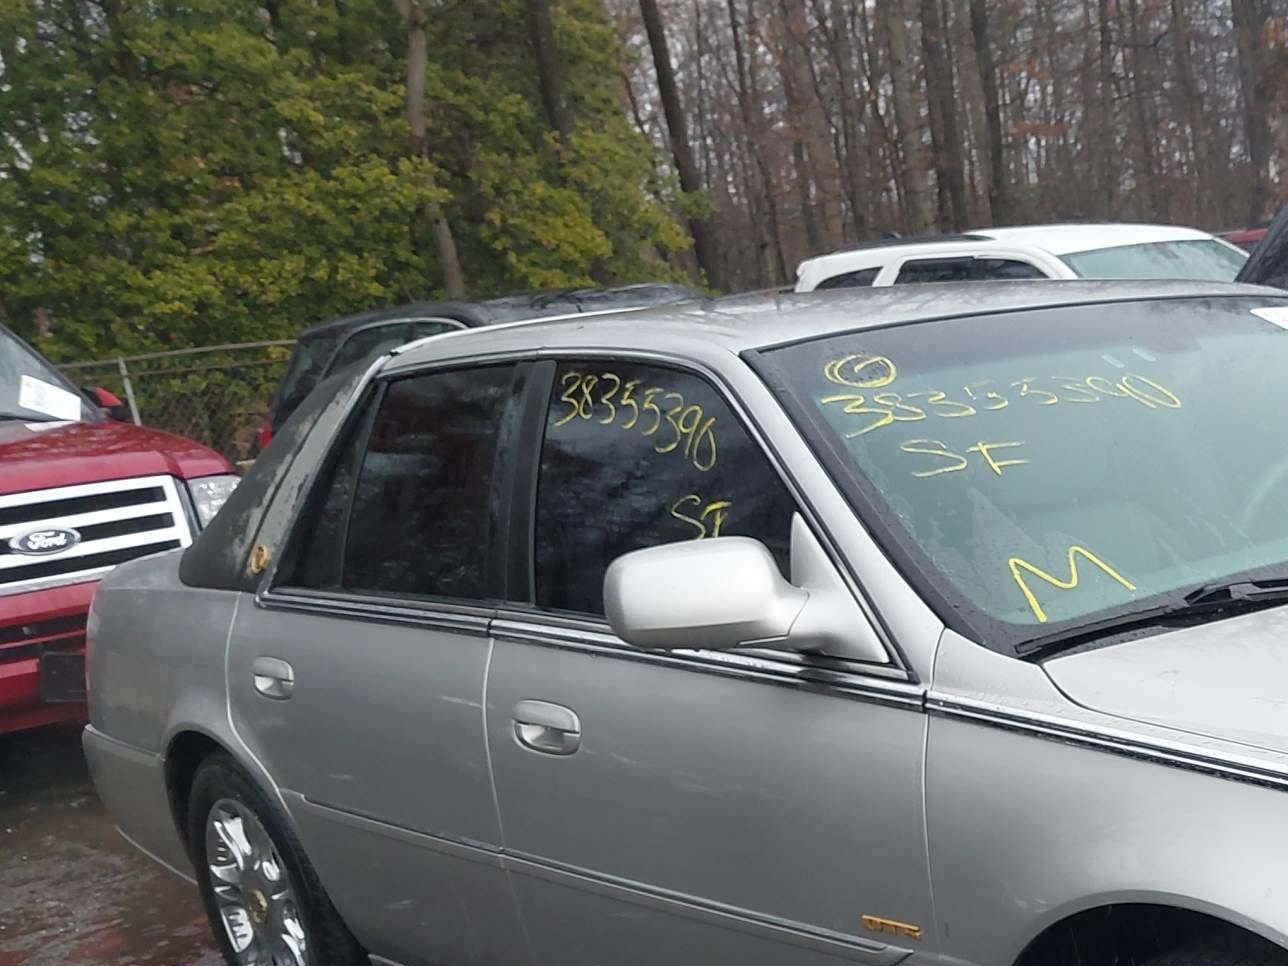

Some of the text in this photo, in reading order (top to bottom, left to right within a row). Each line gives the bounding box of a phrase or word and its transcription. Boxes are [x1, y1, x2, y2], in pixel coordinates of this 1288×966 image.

[554, 372, 717, 472] 38355390
[27, 531, 67, 550] Ford
[1009, 546, 1137, 624] M
